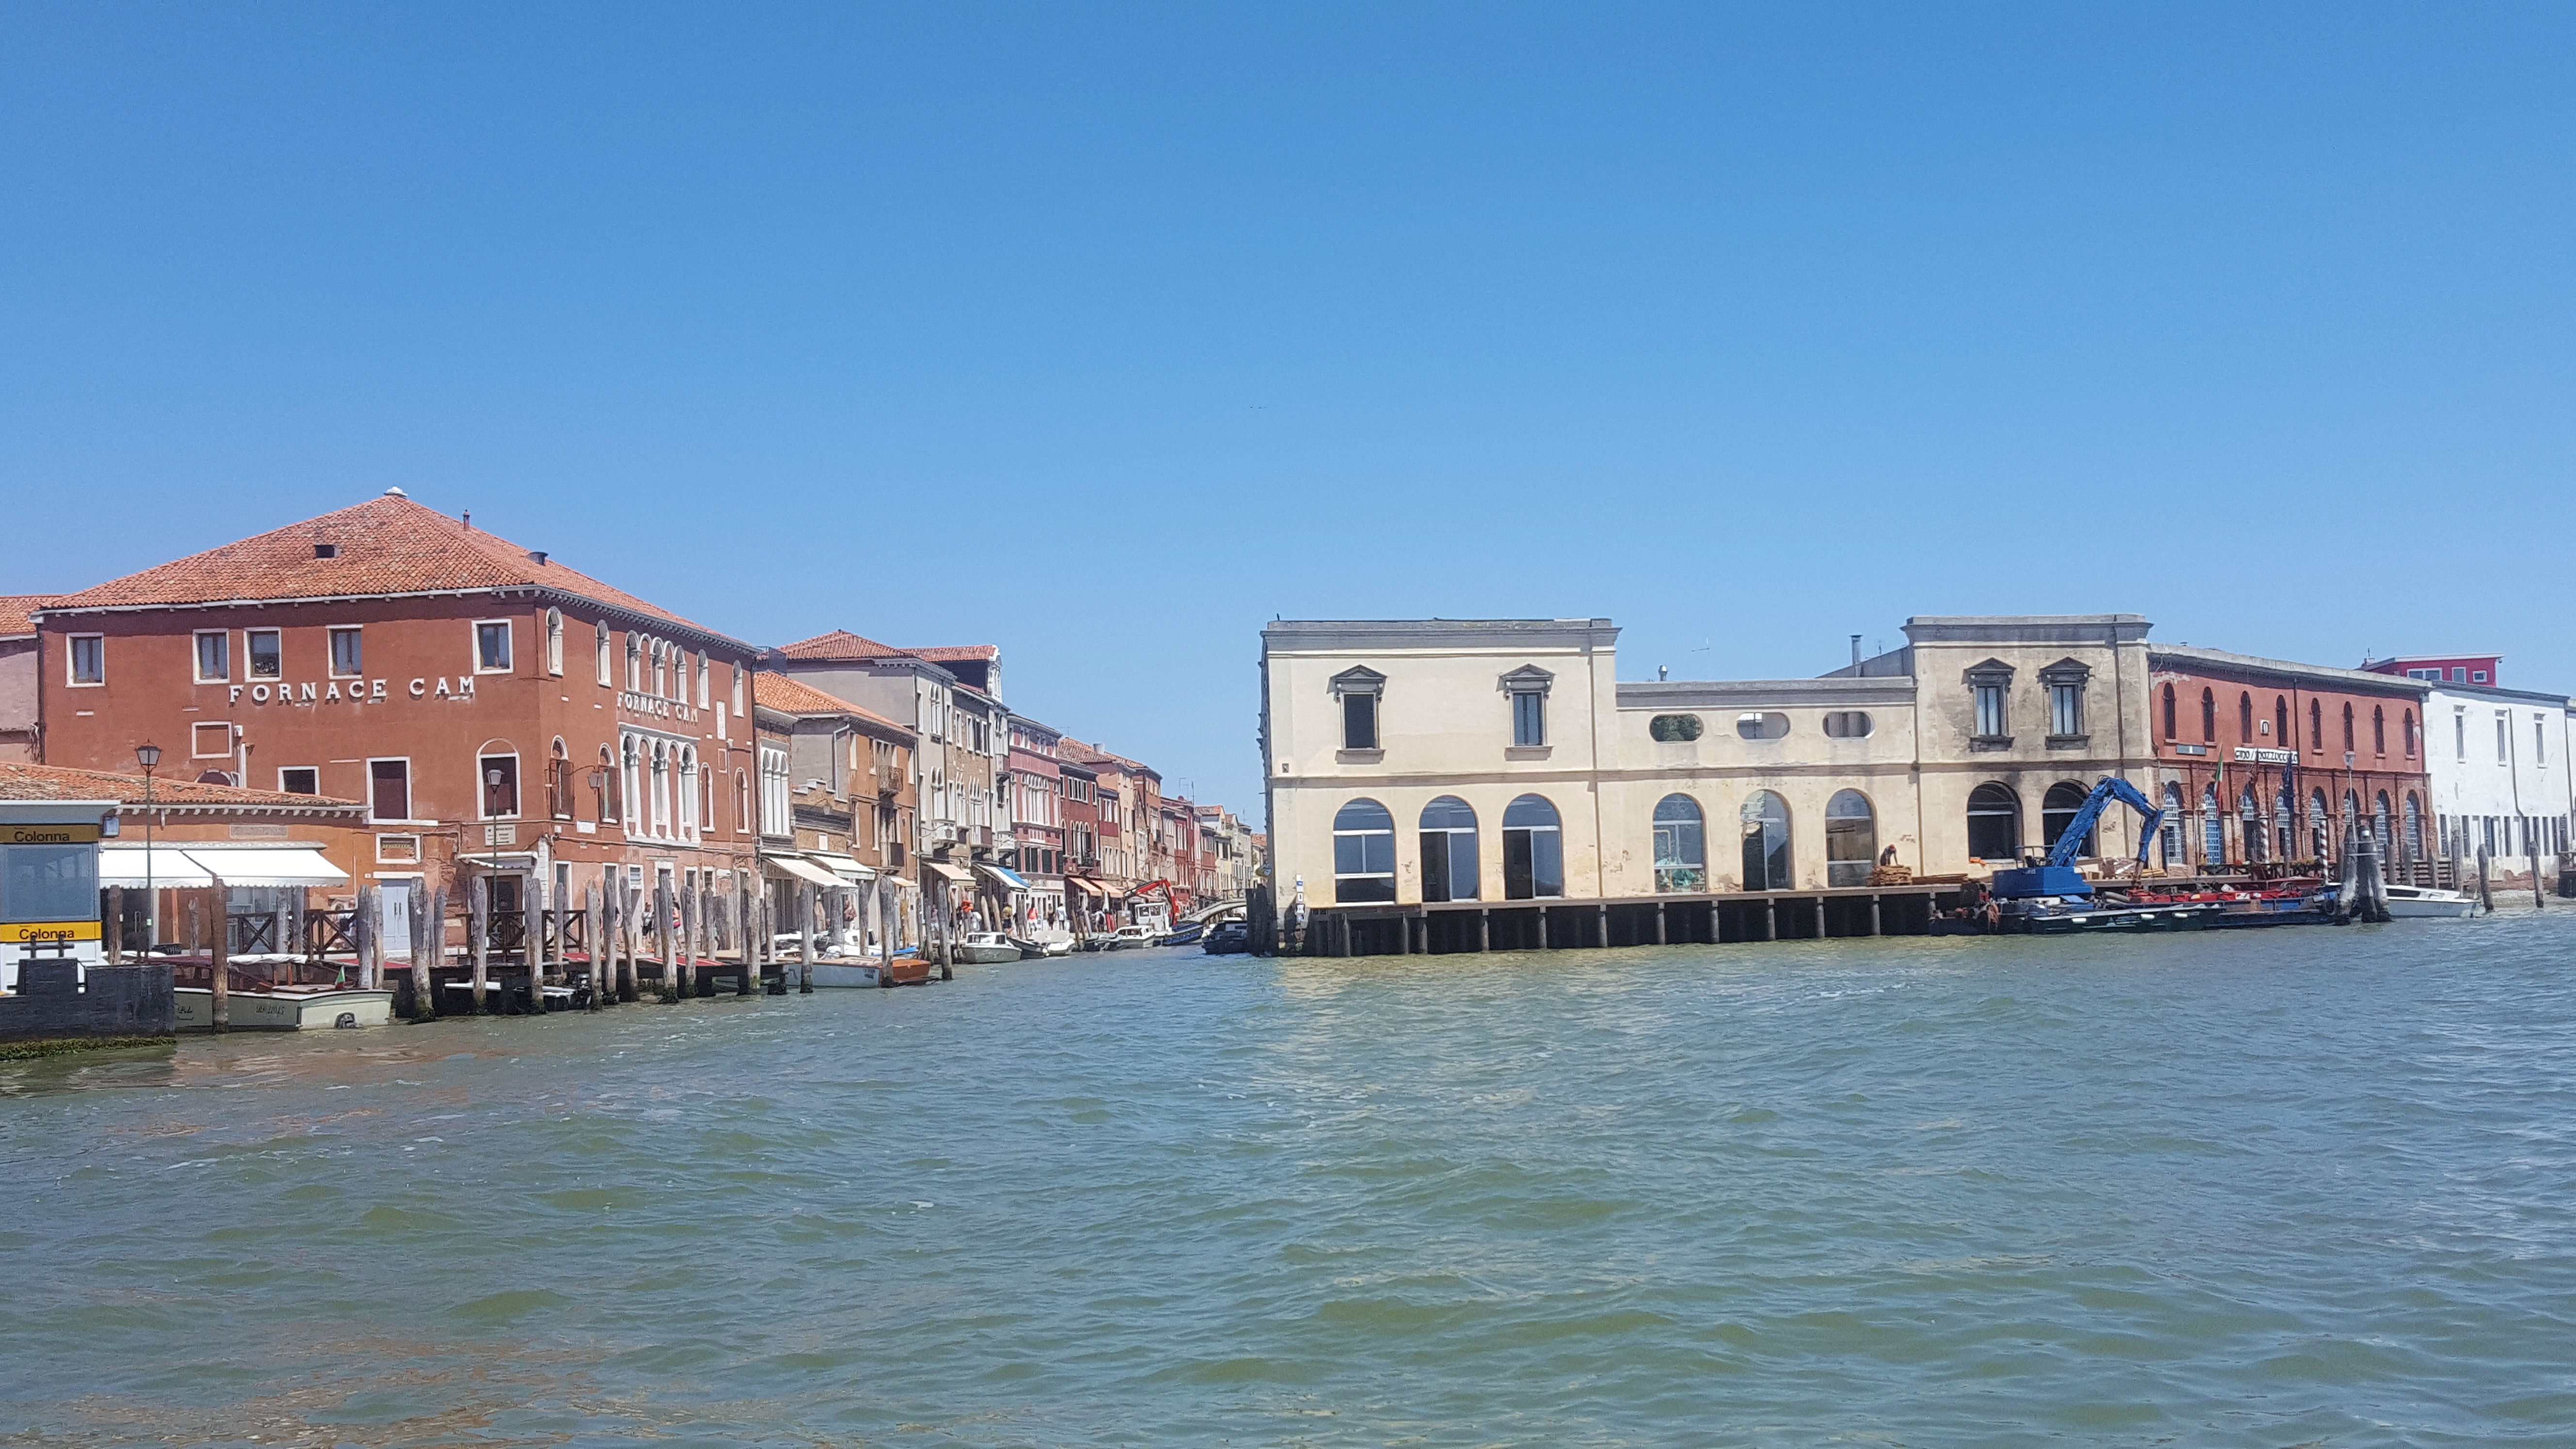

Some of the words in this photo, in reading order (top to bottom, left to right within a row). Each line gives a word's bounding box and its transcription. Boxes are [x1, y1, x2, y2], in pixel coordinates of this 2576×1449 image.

[229, 679, 387, 703] FORNACE
[409, 676, 475, 696] CAM
[617, 692, 669, 717] FORNACE
[14, 831, 70, 842] Colonna
[19, 928, 75, 940] Colonna
